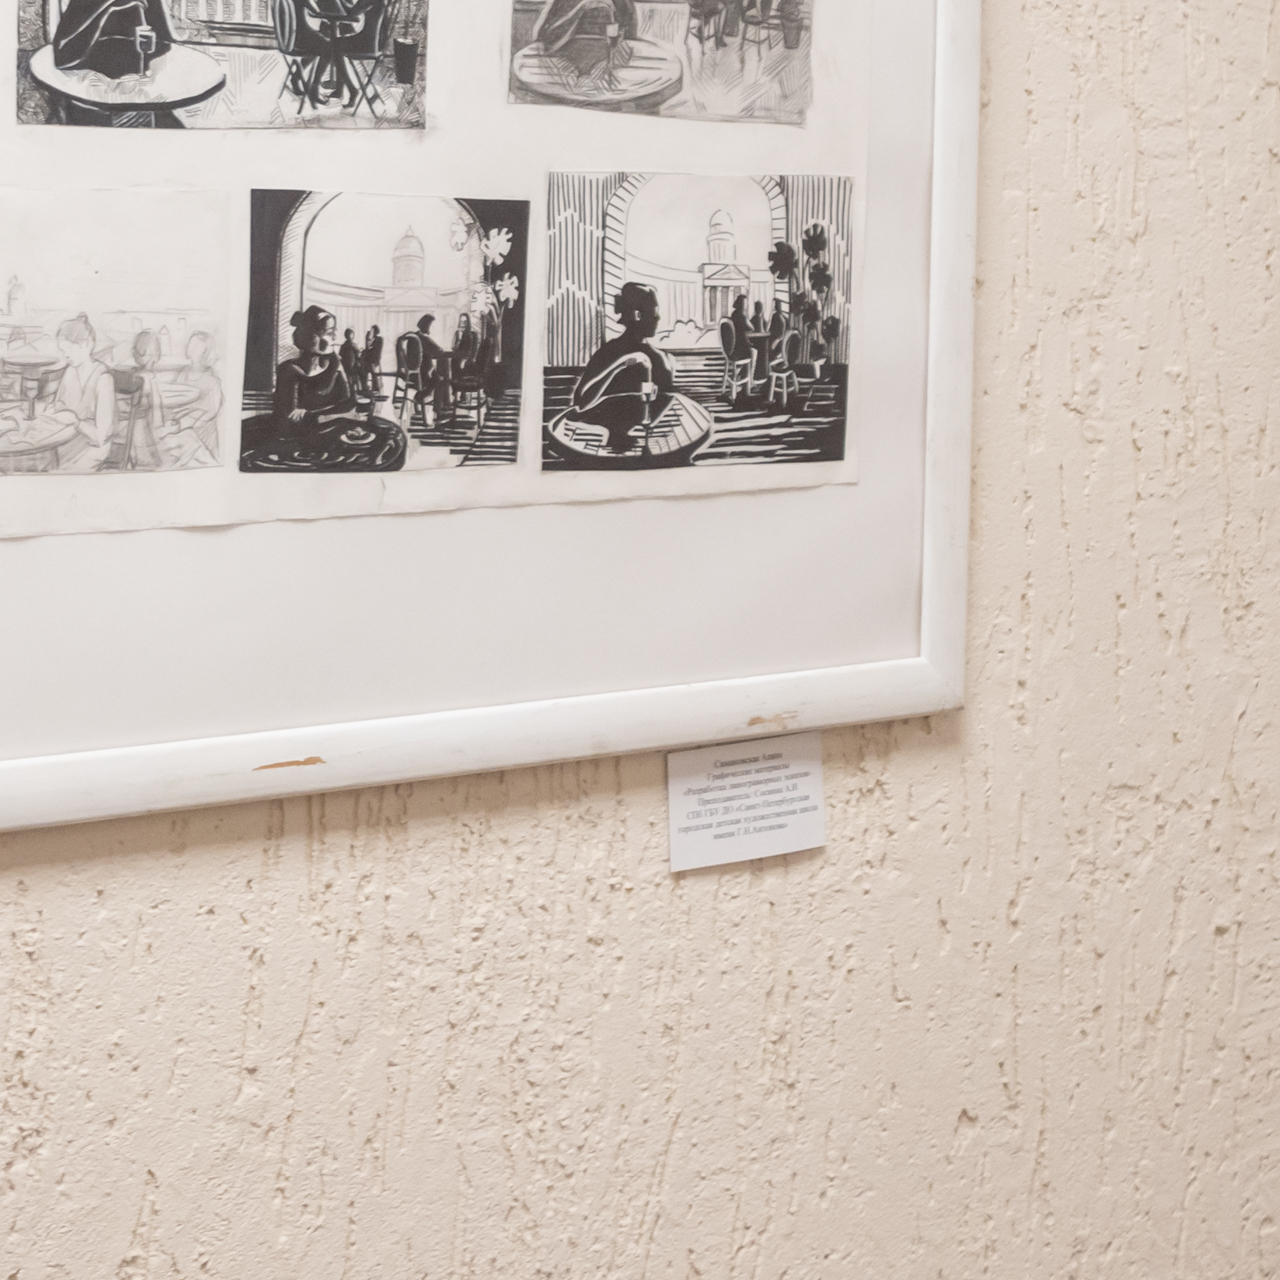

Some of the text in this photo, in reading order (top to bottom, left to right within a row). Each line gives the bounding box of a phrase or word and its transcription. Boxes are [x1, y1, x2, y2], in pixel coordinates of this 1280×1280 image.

[708, 763, 790, 782] Графические материалы
[698, 793, 752, 807] Преподаватель:
[704, 808, 720, 817] ГБУ
[722, 806, 734, 816] ДО
[678, 805, 818, 834] городская детская художественная школа
[713, 831, 735, 840] имени
